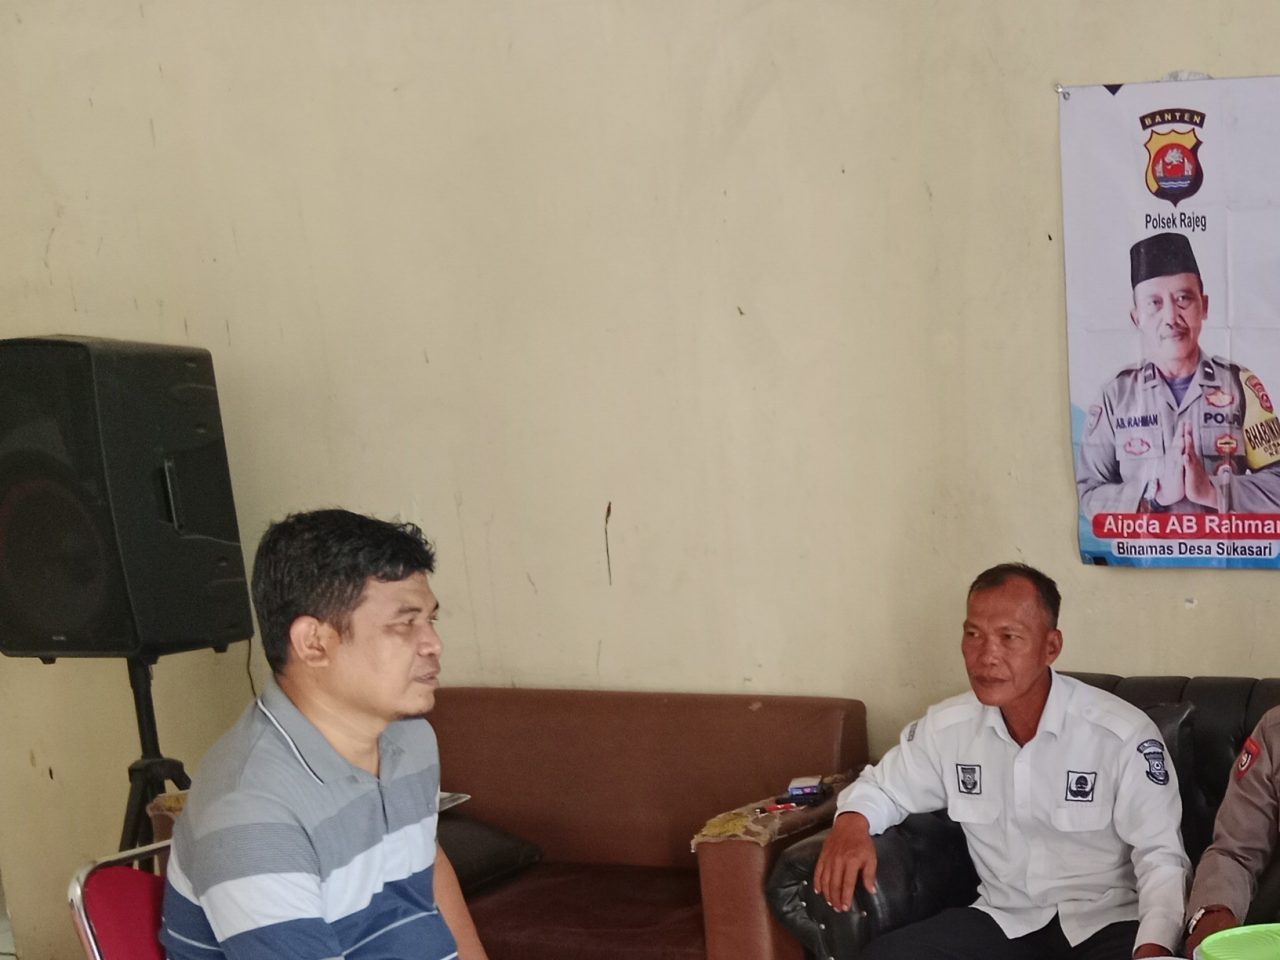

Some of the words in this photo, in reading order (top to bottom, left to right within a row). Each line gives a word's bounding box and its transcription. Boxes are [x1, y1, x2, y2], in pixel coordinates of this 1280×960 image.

[1144, 112, 1202, 126] BANTEN
[1145, 213, 1178, 229] Polsek
[1179, 212, 1207, 231] Rajeg
[1103, 516, 1160, 537] Aipda
[1166, 516, 1197, 533] AB
[1116, 541, 1173, 556] Binamas
[1178, 541, 1212, 556] Desa
[1216, 542, 1272, 557] Sukasari
